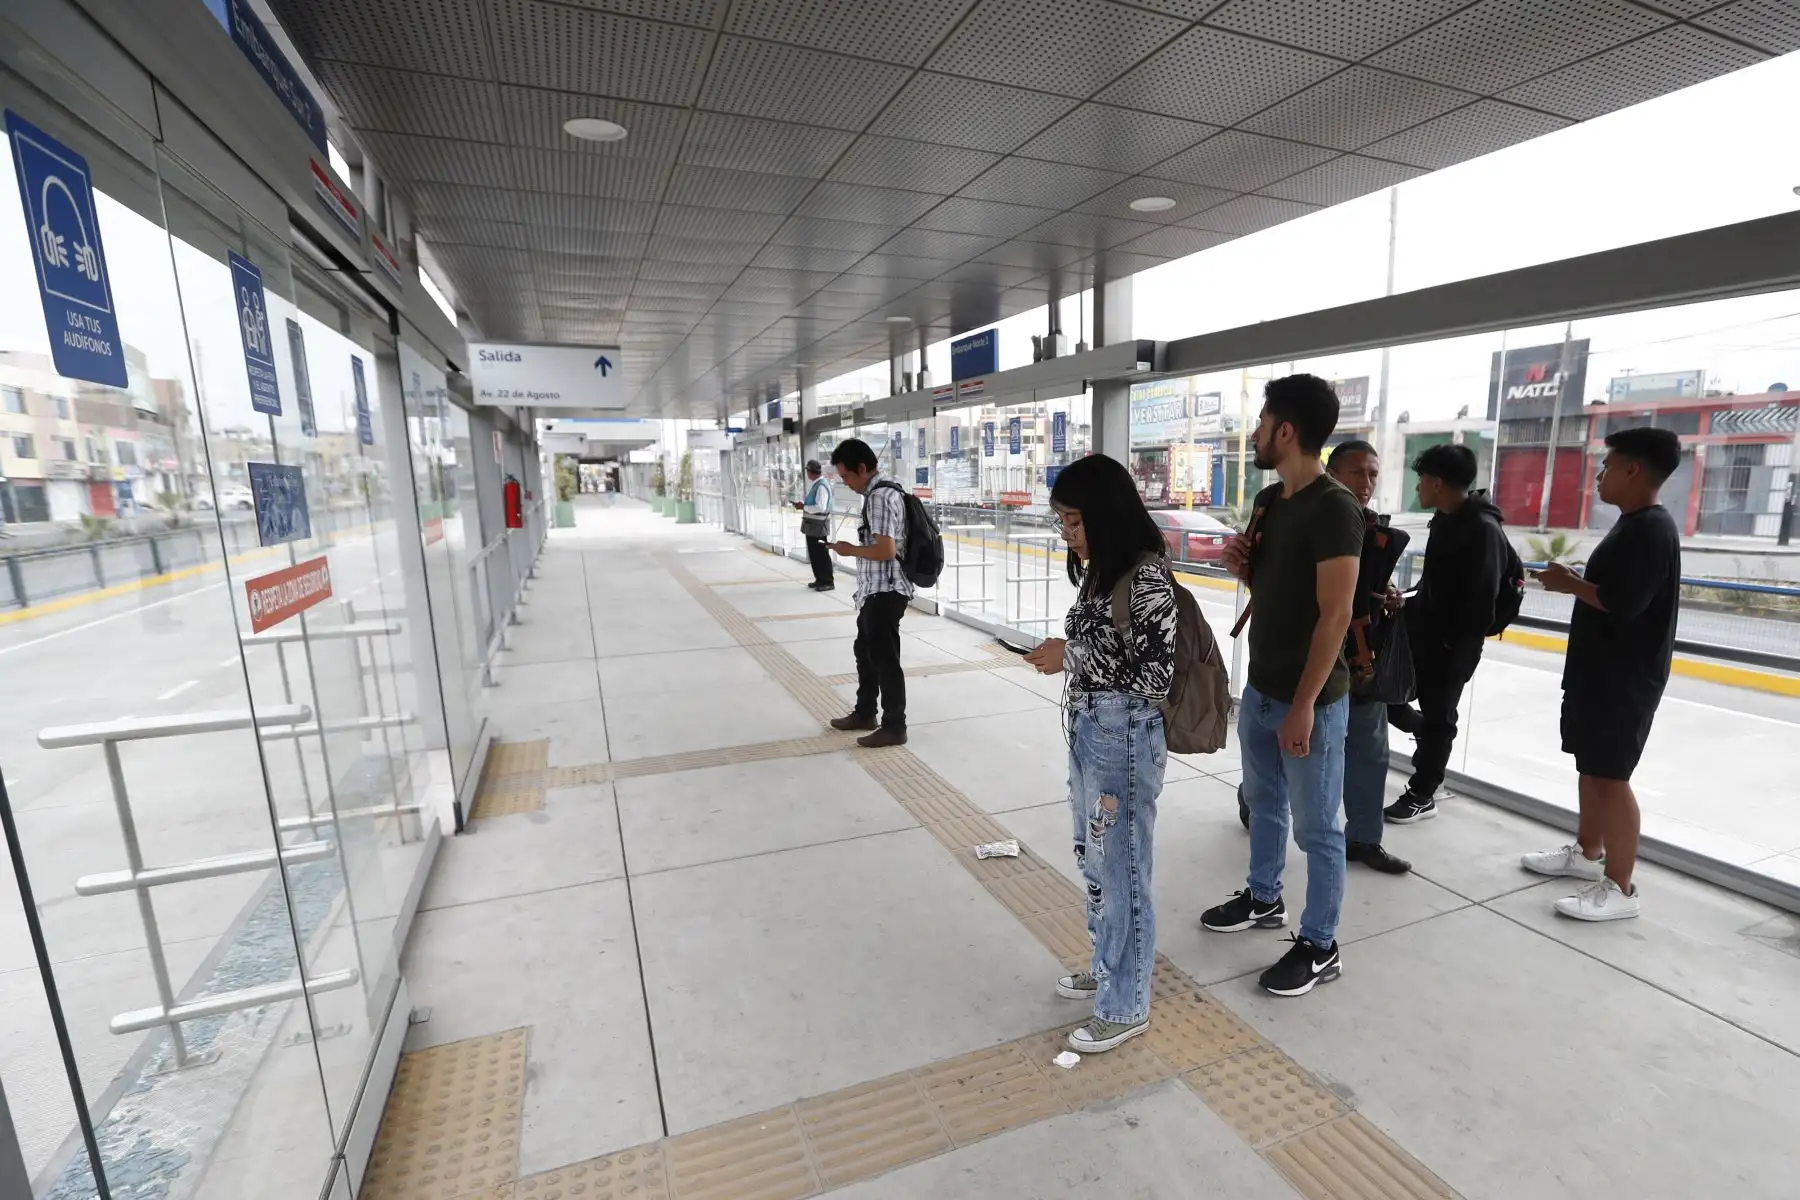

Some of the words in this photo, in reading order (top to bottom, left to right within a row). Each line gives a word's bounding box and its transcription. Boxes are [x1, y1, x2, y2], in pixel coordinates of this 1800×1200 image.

[66, 309, 85, 329] USA
[84, 315, 102, 334] TUS
[64, 330, 112, 356] AUDÍFONOS
[478, 349, 522, 362] Salida
[480, 390, 494, 398] Av.
[497, 389, 509, 398] 22
[512, 390, 524, 398] de
[526, 391, 560, 400] Agosto
